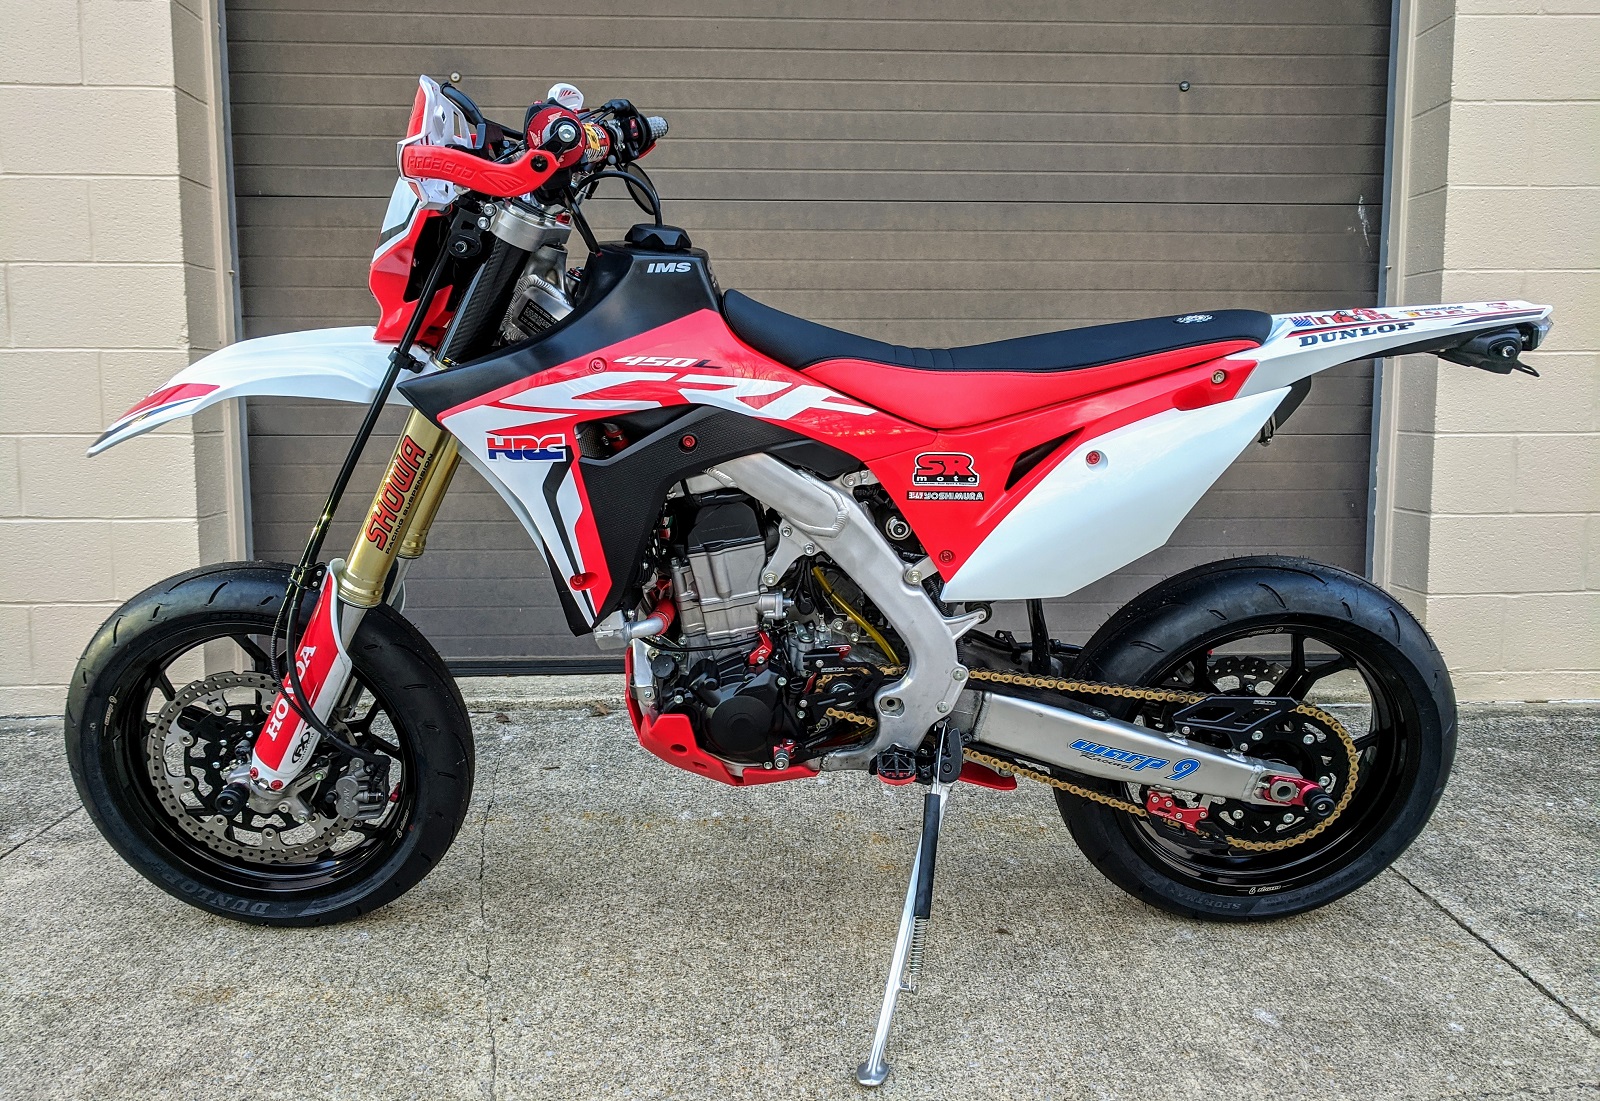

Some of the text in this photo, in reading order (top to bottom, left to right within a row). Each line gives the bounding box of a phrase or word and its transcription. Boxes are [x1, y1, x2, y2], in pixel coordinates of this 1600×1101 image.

[646, 262, 692, 274] IMS
[1298, 321, 1415, 348] DUNLOP
[486, 434, 566, 461] HRC
[916, 453, 975, 476] SR
[365, 434, 427, 551] SHOWA
[385, 453, 434, 555] RACING SUSPENSION
[923, 491, 984, 501] YOSHIMURA
[1069, 738, 1202, 781] warp 9
[161, 871, 270, 915] DUNLOP
